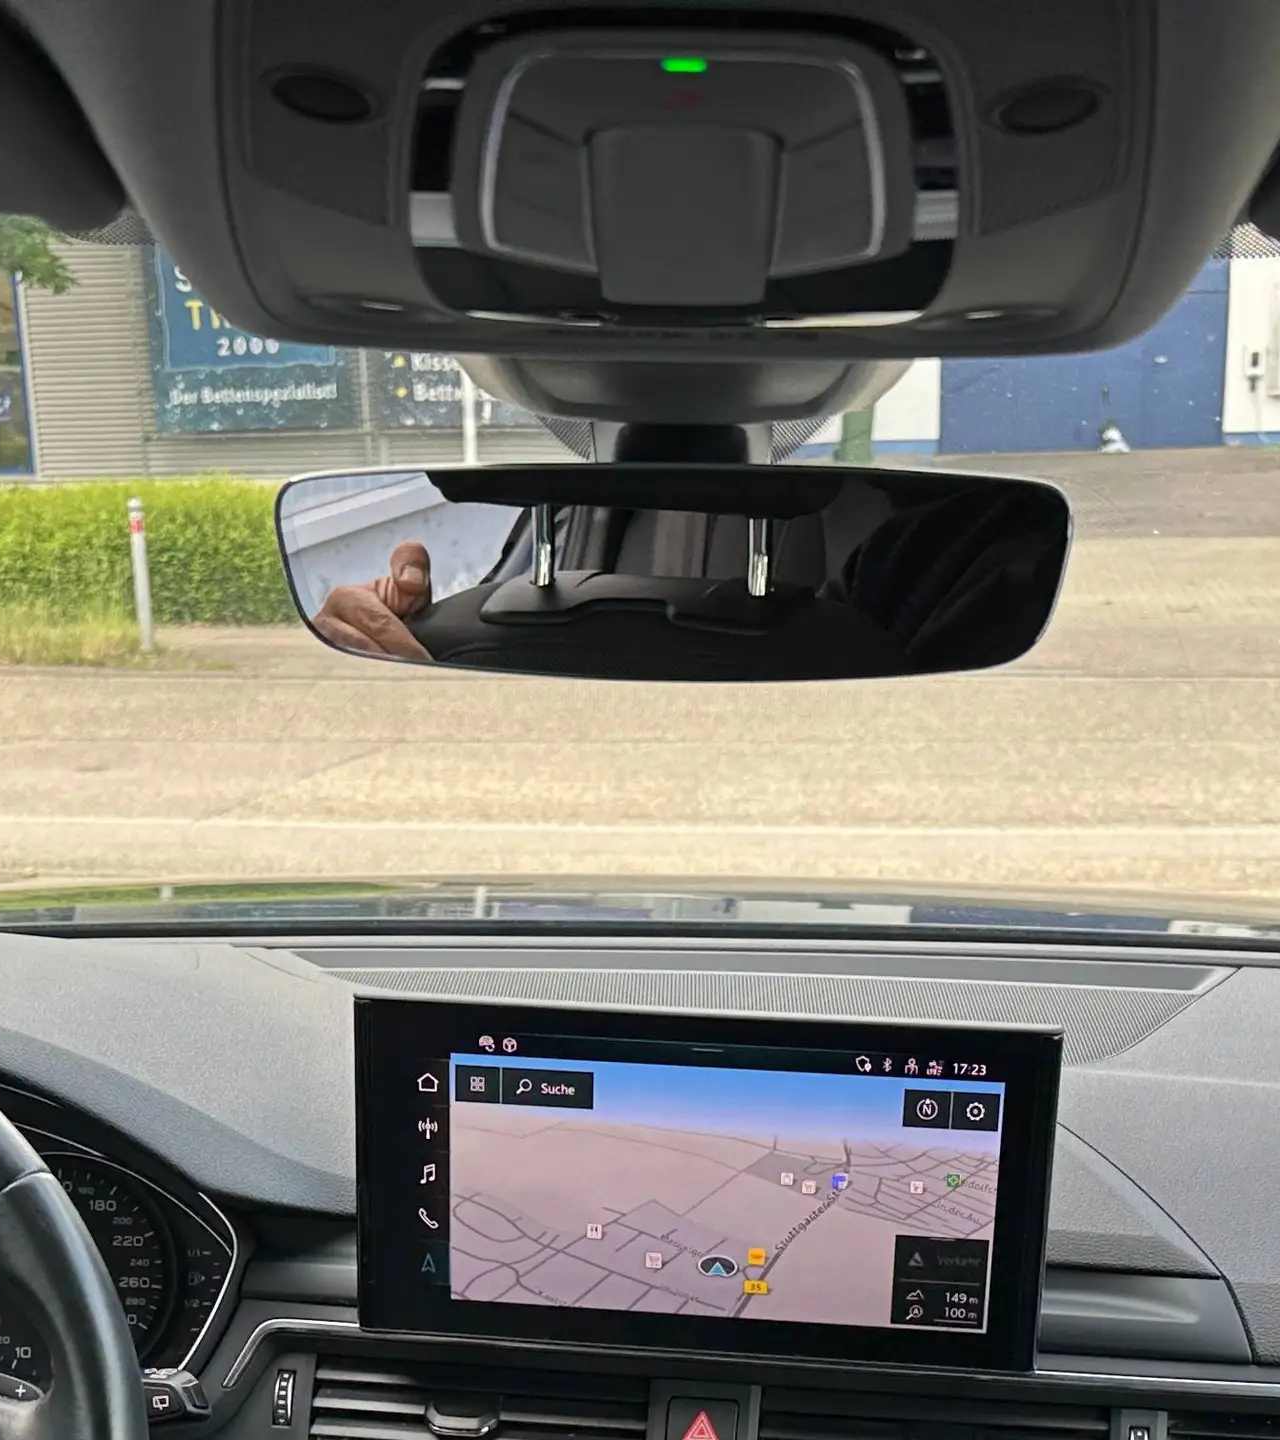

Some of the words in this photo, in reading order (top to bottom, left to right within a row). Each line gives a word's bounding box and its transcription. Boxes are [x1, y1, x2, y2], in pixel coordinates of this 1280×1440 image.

[953, 1063, 987, 1076] 17:23
[540, 1083, 576, 1096] Suche
[88, 1199, 117, 1212] 180
[112, 1234, 144, 1247] 220
[129, 1258, 150, 1267] 240
[118, 1276, 150, 1289] 260
[945, 1292, 967, 1304] 149
[944, 1307, 966, 1319] 100
[14, 1346, 32, 1359] 10
